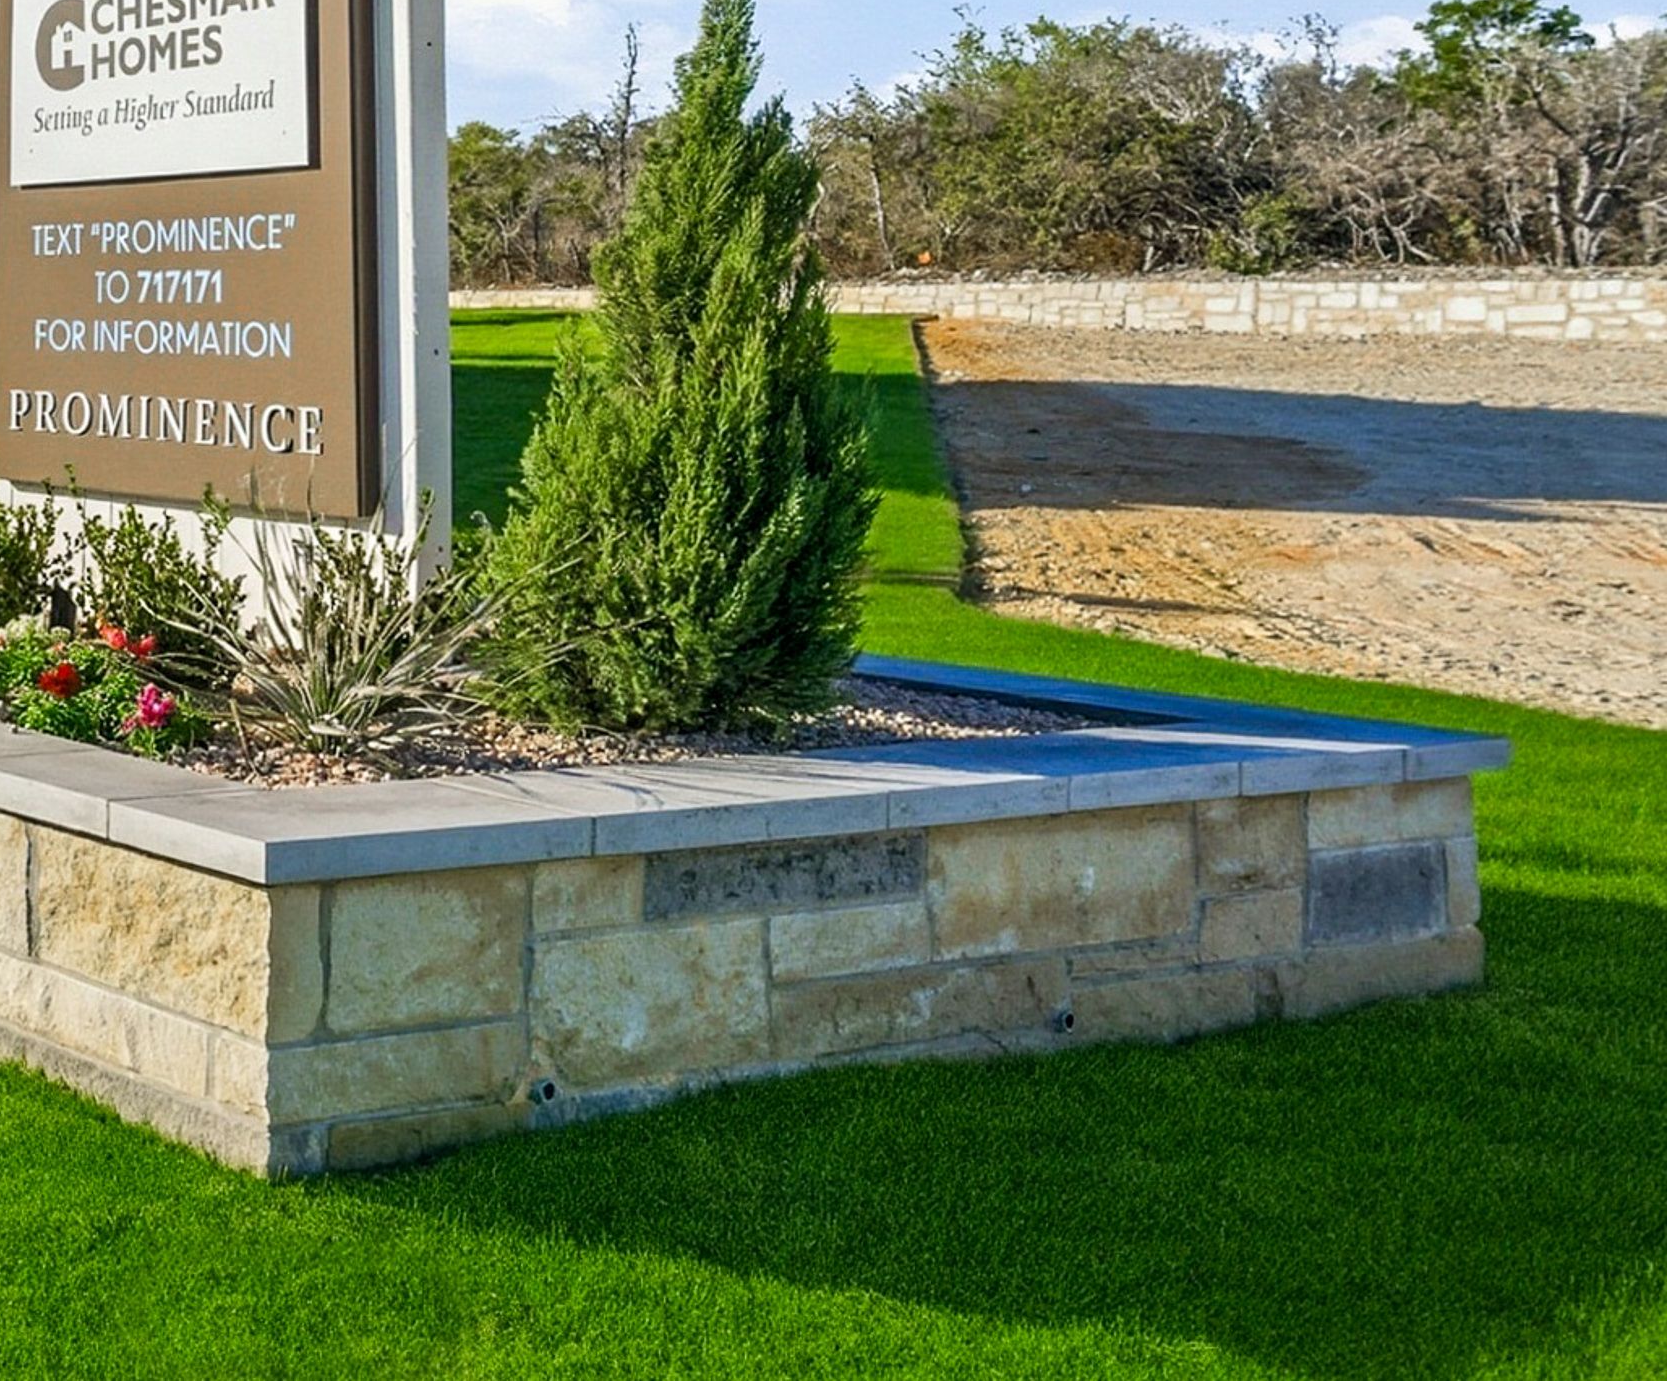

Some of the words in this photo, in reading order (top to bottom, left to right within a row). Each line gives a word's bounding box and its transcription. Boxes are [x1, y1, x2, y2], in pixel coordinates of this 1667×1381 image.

[91, 25, 223, 80] HOMES
[33, 105, 93, 136] Setting
[97, 110, 108, 126] a
[114, 94, 179, 131] Higher
[183, 79, 275, 118] Standard
[31, 223, 85, 256] TEXT
[90, 214, 296, 254] "PROMINENCE"
[94, 270, 131, 304] TO
[137, 269, 223, 304] 717171
[34, 319, 87, 351] FOR
[93, 320, 292, 358] INFORMATION
[9, 388, 323, 456] PROMINENCE
